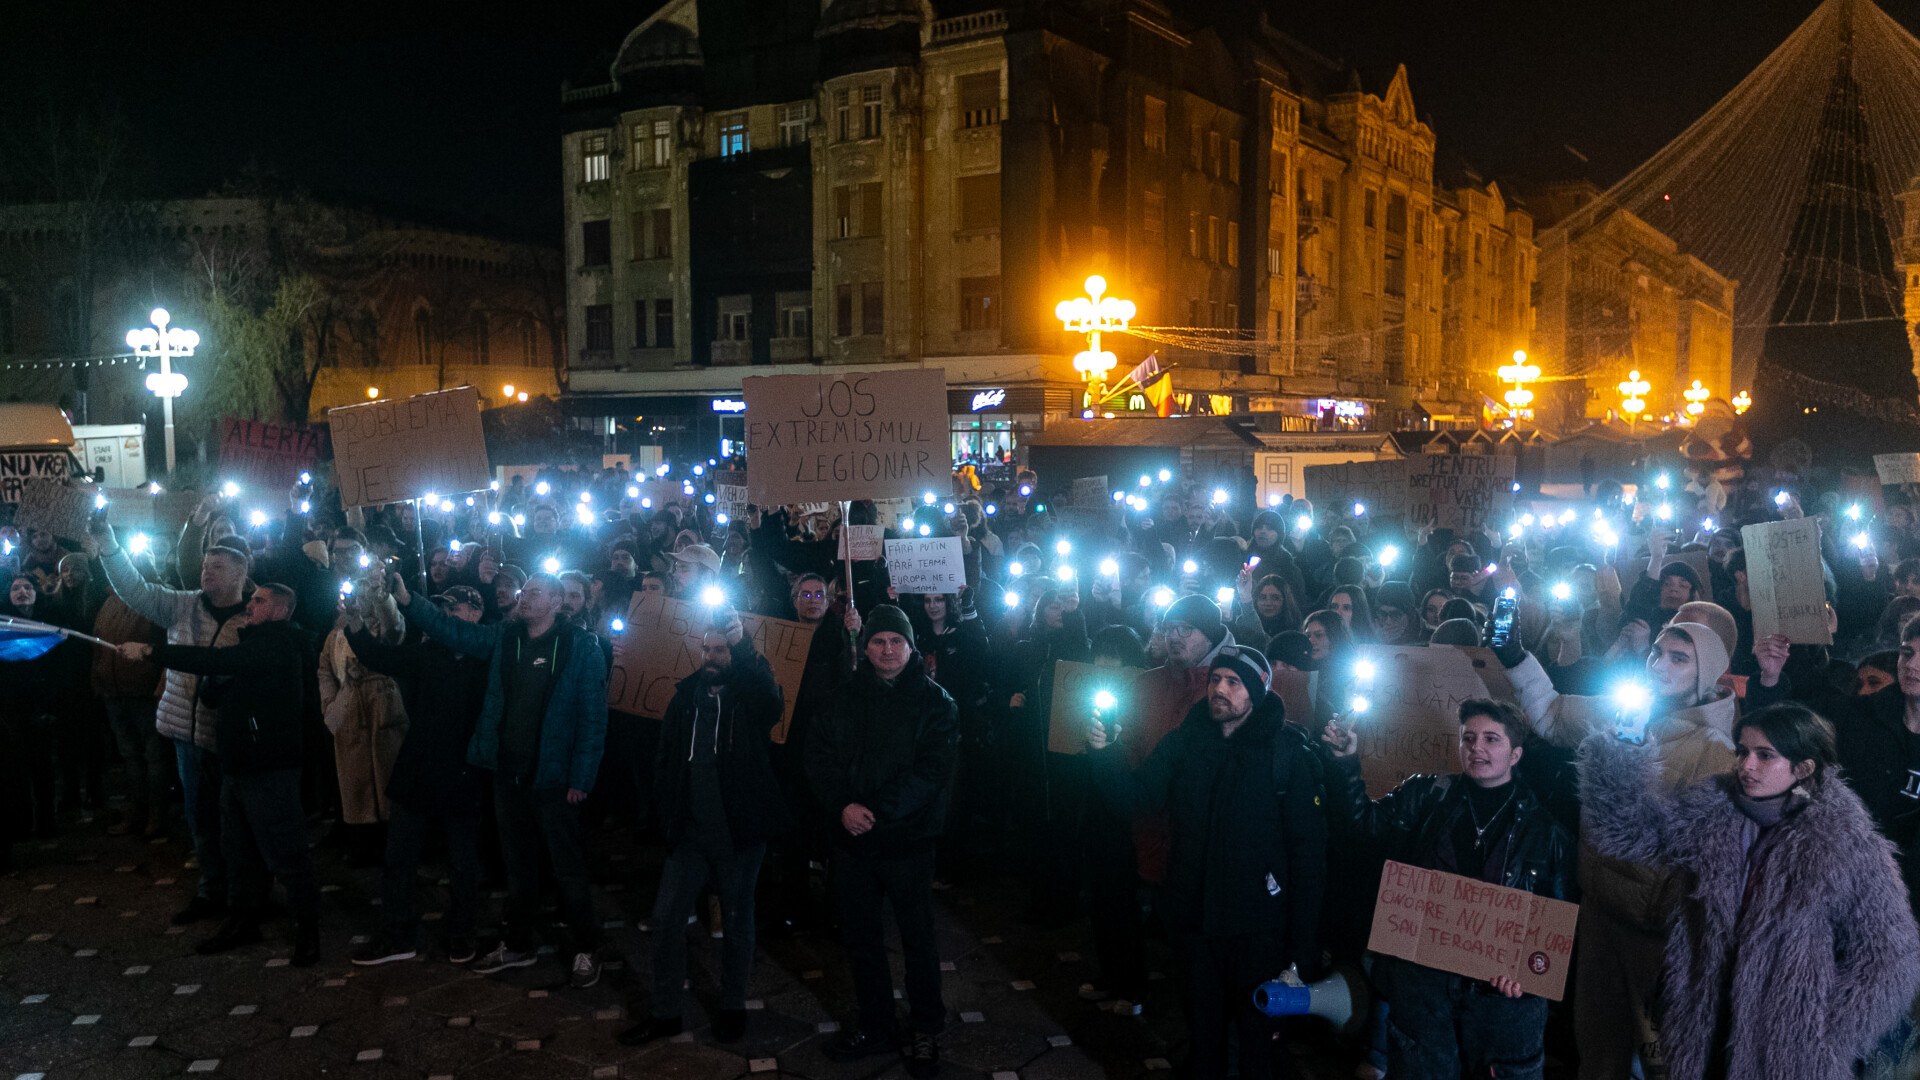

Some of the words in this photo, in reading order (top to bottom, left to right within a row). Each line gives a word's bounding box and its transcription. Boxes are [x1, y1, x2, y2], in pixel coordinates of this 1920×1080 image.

[801, 378, 876, 417] JOS
[226, 420, 320, 457] ALERTA
[331, 395, 461, 446] PROBLEMA
[750, 418, 930, 450] EXTREMISMUL
[796, 451, 935, 482] LEGIONAR
[1428, 455, 1497, 475] PENTRU
[920, 541, 946, 552] PUTIN
[892, 574, 926, 585] EUROPA
[629, 595, 814, 663] LIBEATE
[1386, 862, 1446, 895] PENTRU
[1454, 880, 1523, 911] DREPTURI
[1388, 914, 1419, 938] SAU
[1429, 927, 1507, 964] TEROARE
[1456, 908, 1487, 937] NU
[1495, 918, 1541, 946] VREM
